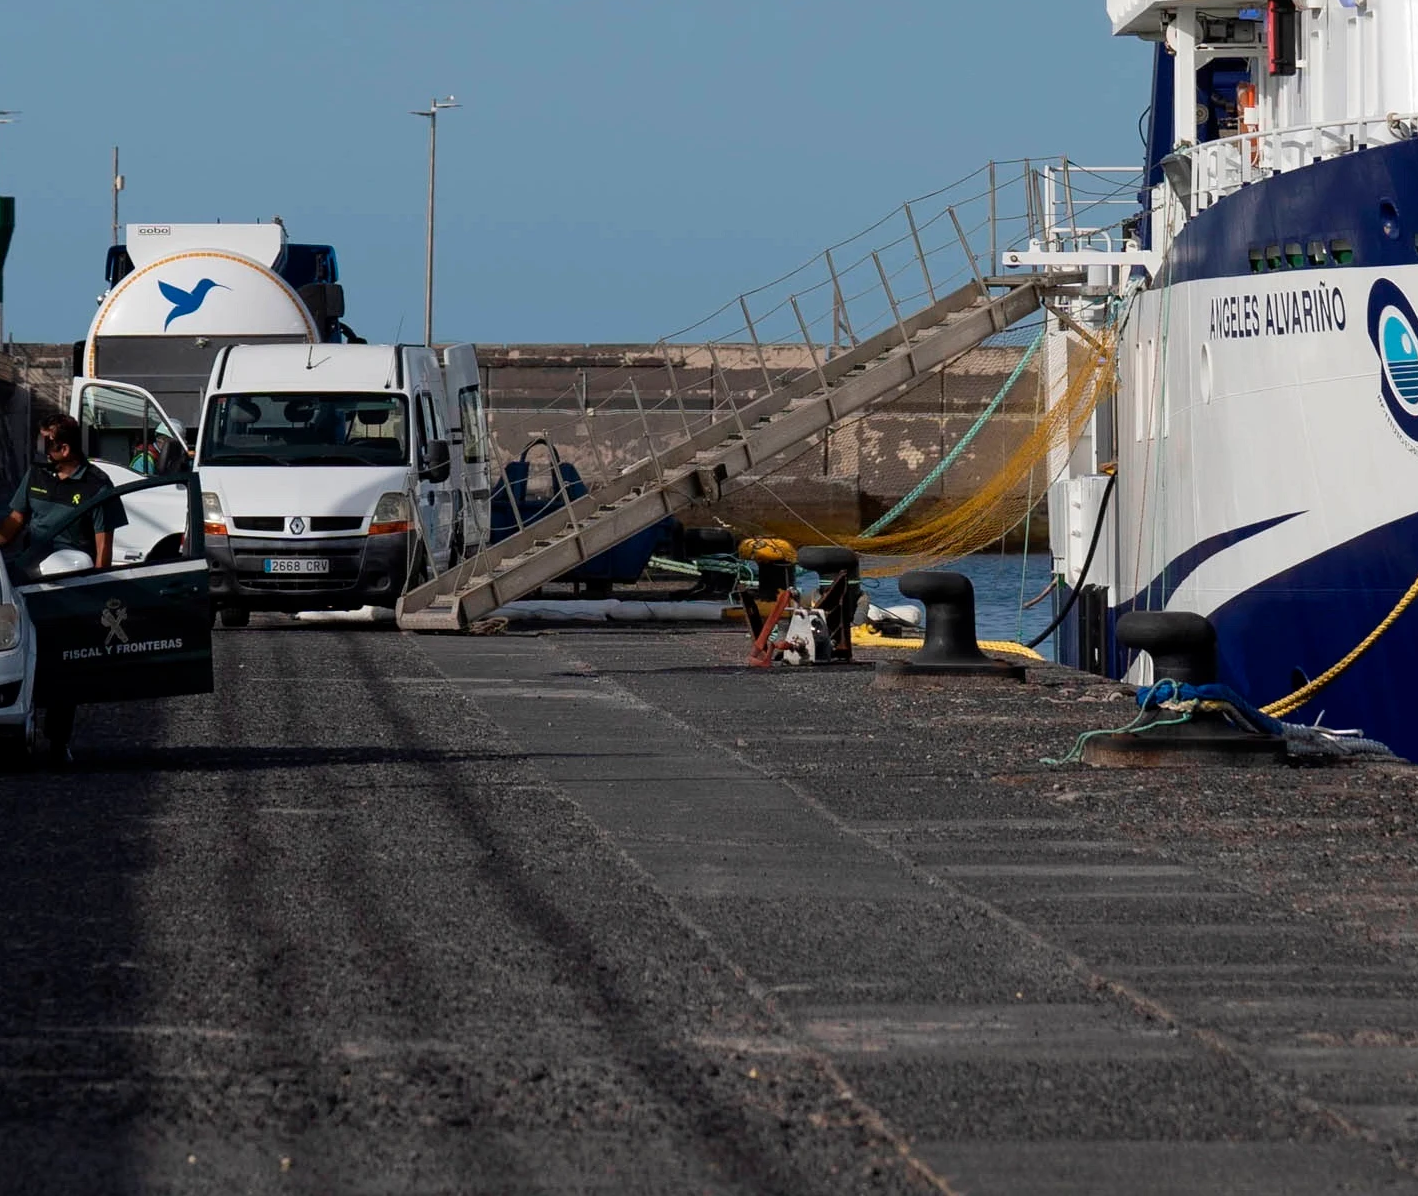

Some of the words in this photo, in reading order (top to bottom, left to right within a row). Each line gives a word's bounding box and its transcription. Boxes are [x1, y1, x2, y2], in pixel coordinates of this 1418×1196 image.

[1209, 294, 1260, 340] ANGELES
[1265, 281, 1347, 337] ALVARIÑO
[272, 560, 301, 572] 2668
[306, 560, 328, 572] CRV
[62, 645, 103, 661] FISCAL
[105, 645, 114, 656] Y
[116, 637, 183, 654] FRONTERAS
